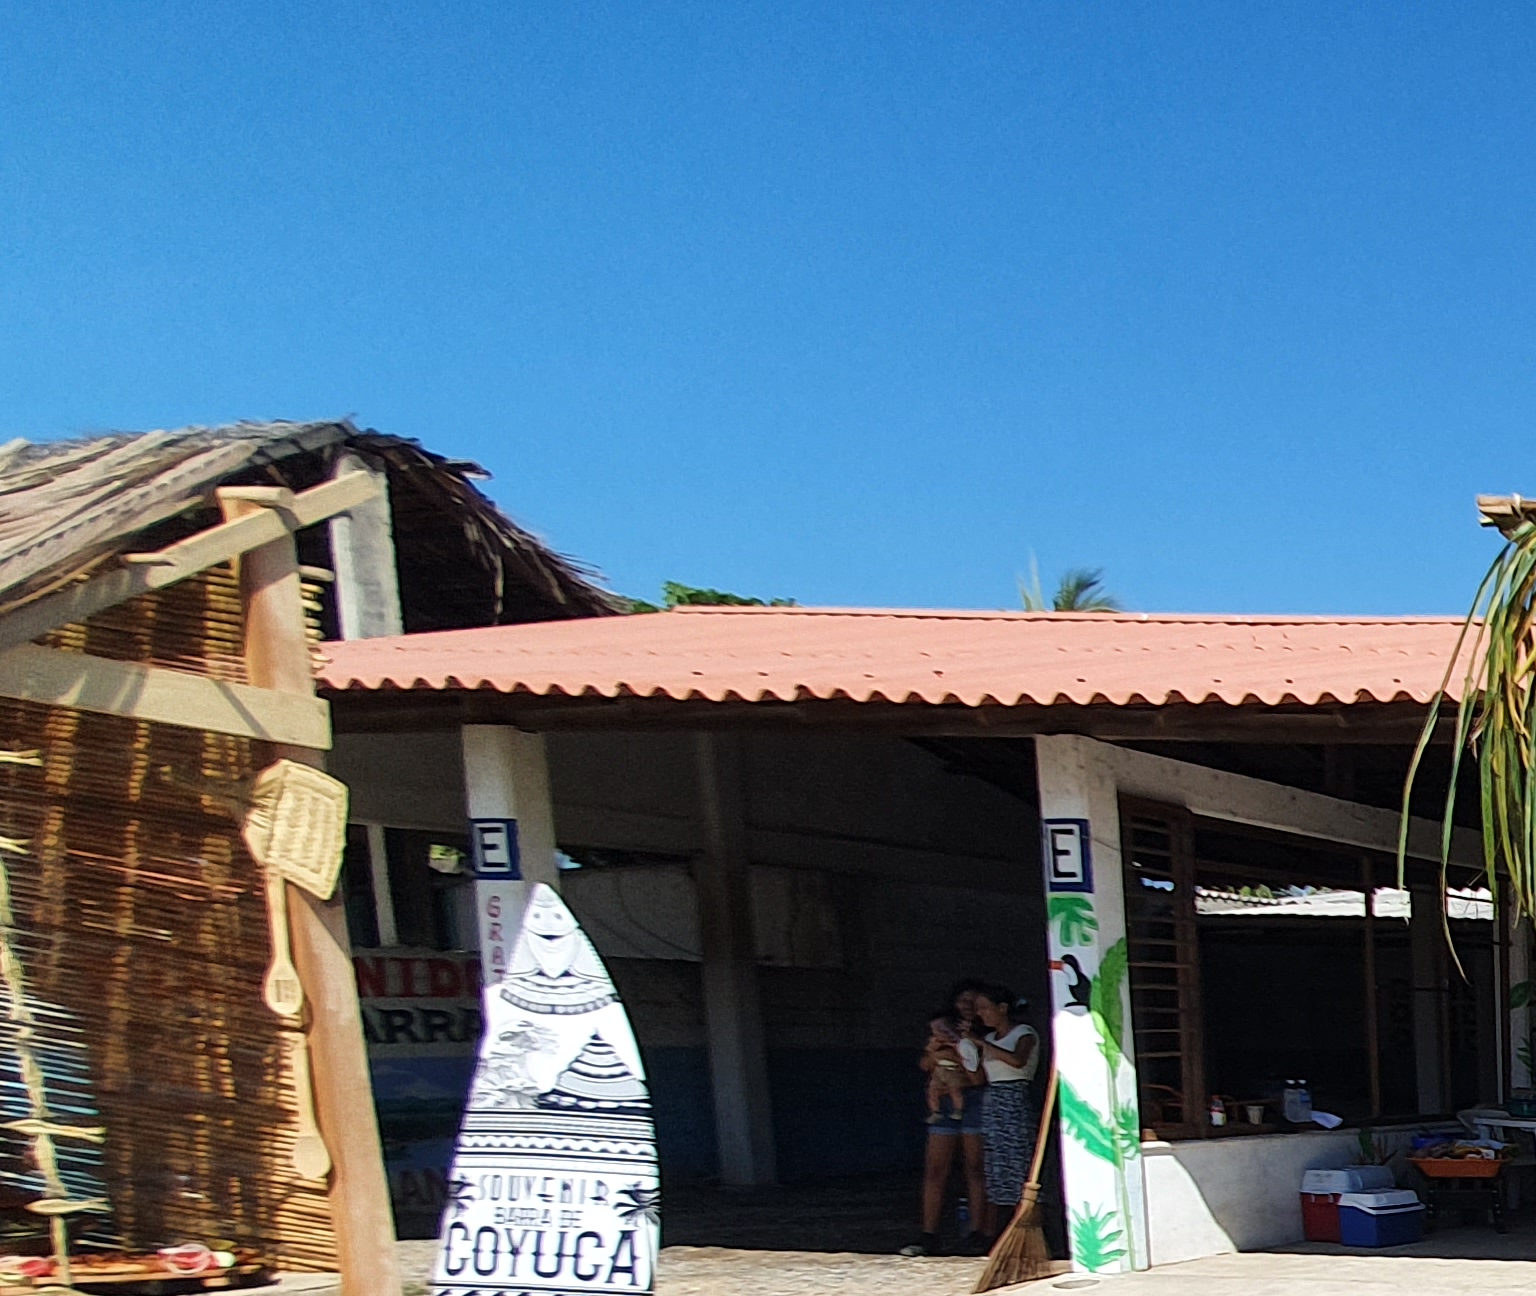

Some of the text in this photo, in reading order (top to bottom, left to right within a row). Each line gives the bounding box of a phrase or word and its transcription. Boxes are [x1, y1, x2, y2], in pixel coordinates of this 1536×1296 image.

[478, 826, 508, 867] E
[1050, 828, 1078, 878] E
[479, 1174, 610, 1206] SOUVENIR
[494, 1206, 585, 1229] BARRA DE
[444, 1221, 641, 1286] COYUCA
